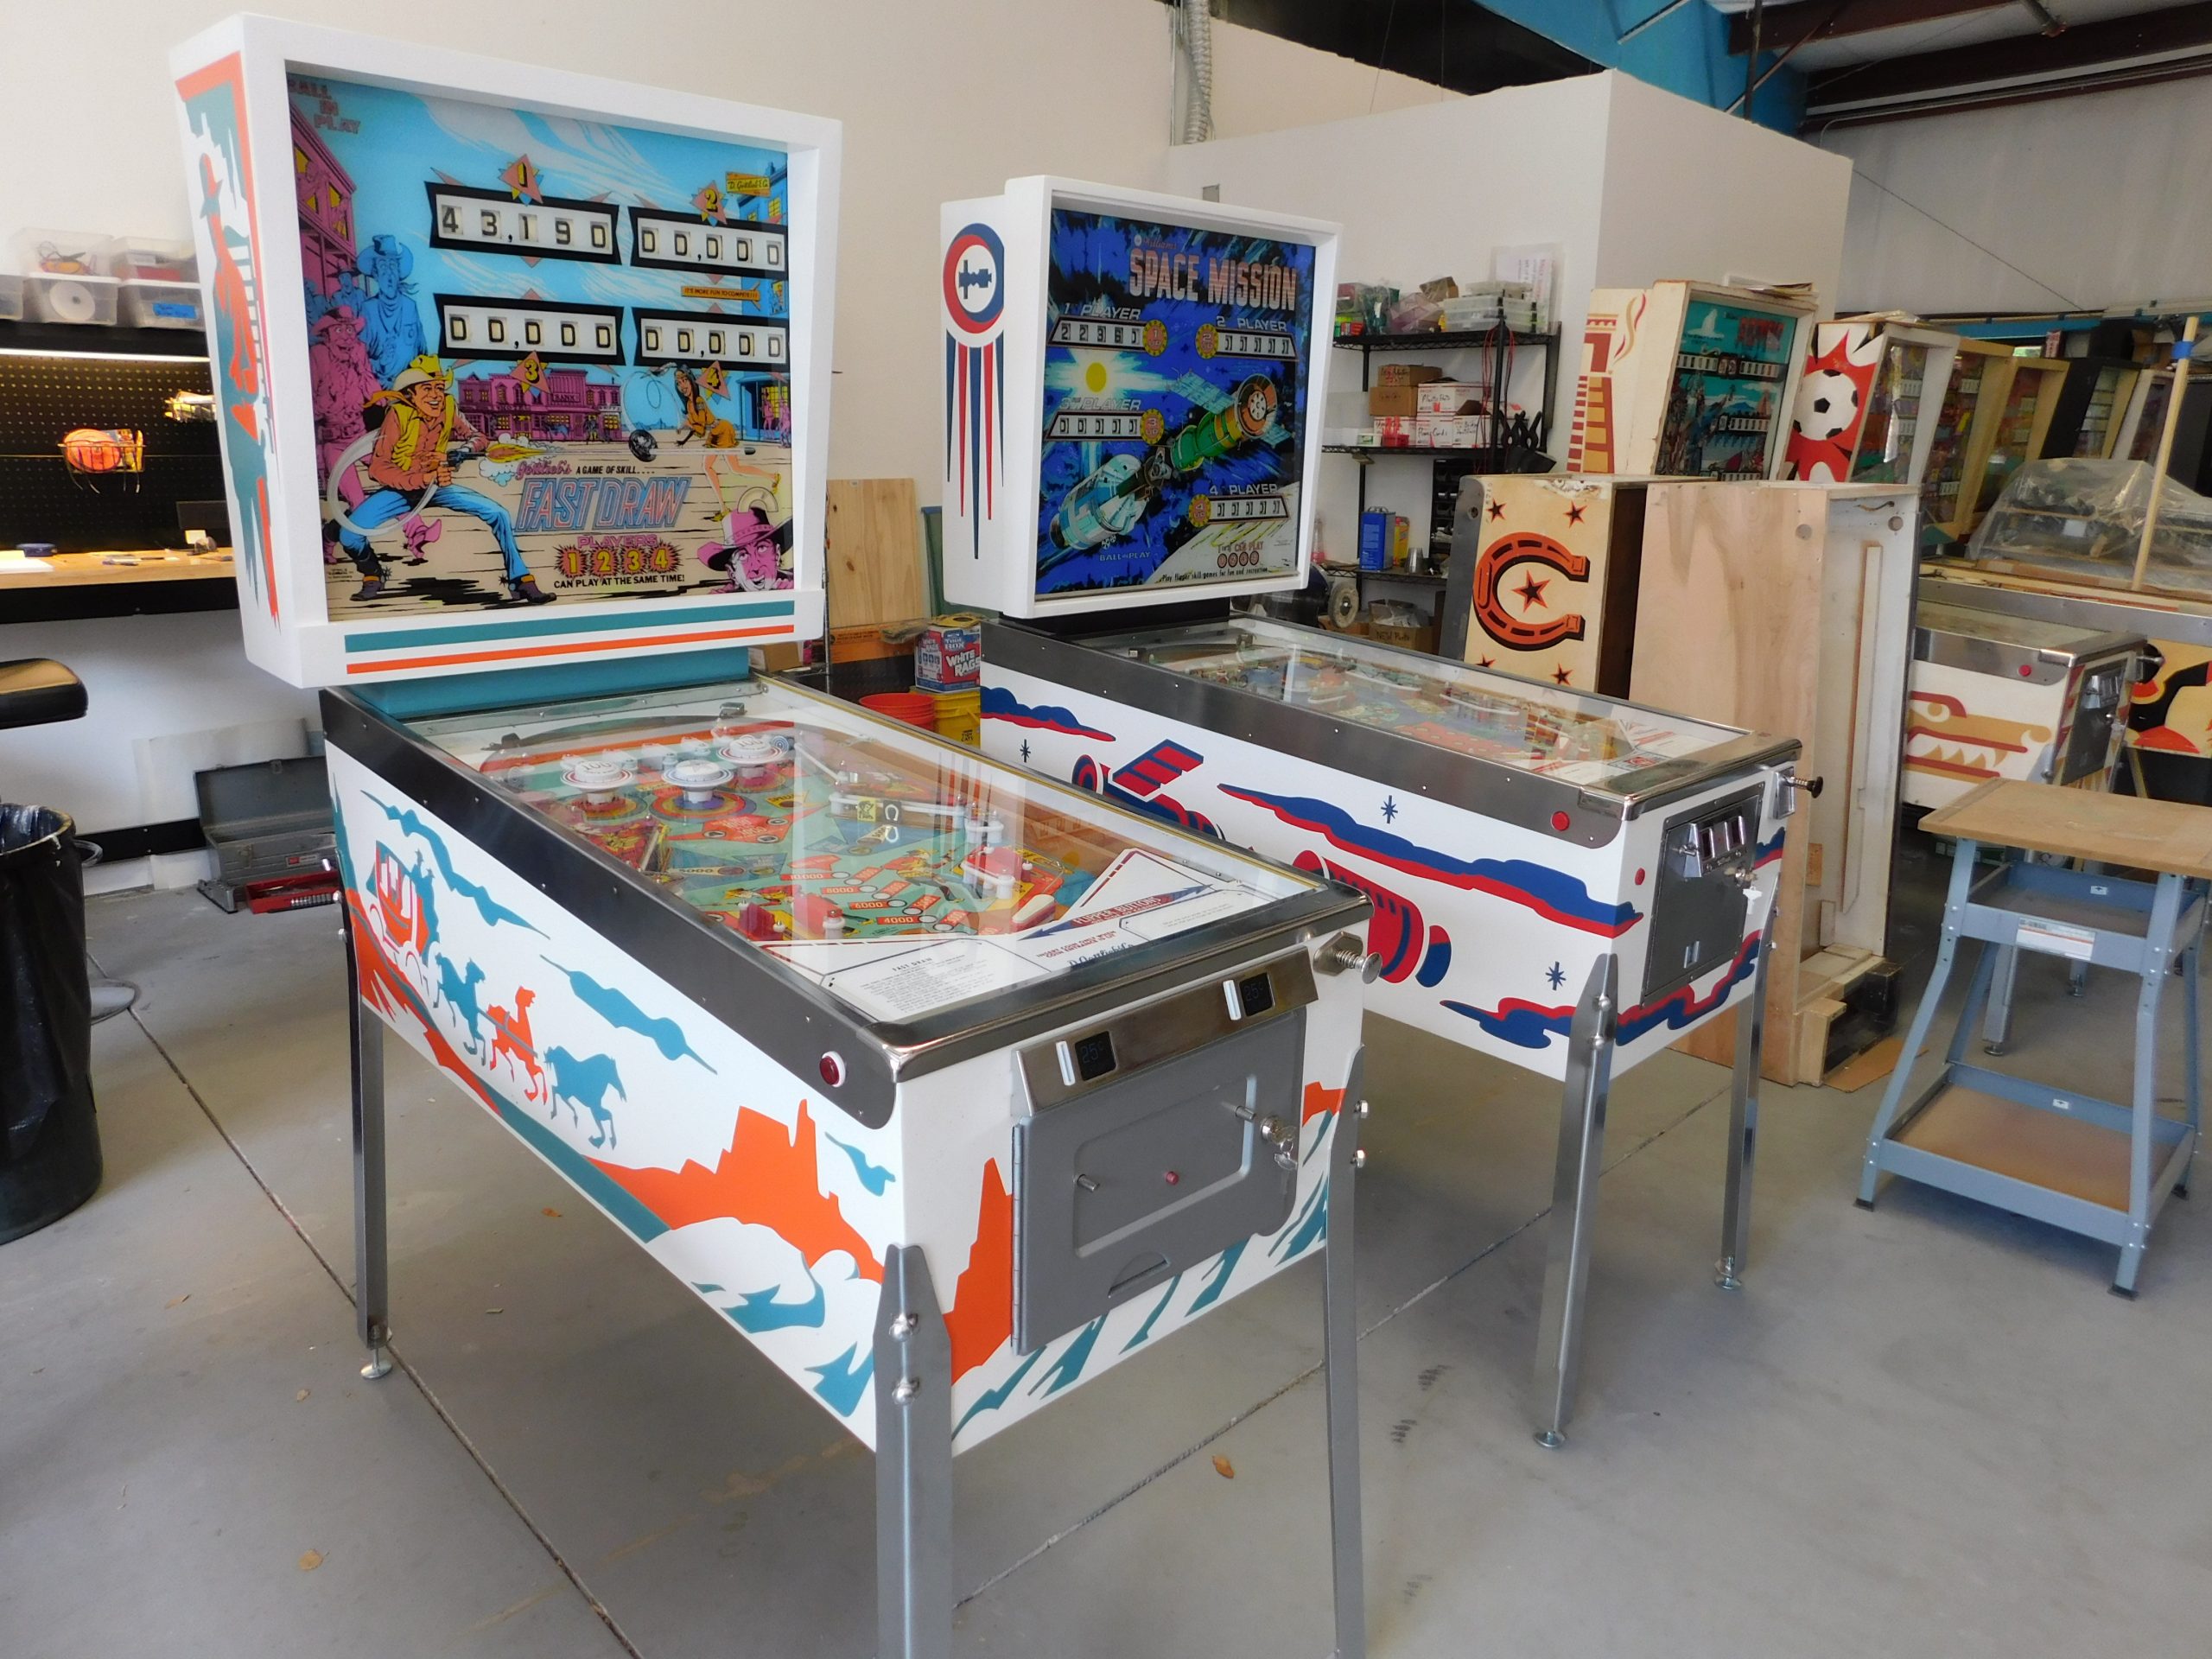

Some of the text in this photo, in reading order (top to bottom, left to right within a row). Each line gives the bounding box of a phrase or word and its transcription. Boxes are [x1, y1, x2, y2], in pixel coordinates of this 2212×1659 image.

[704, 188, 718, 213] 2
[1129, 247, 1297, 311] SPACE MISSION
[1080, 304, 1141, 321] PLAYER
[1216, 315, 1287, 332] 2 PLAYER
[524, 359, 541, 384] 3
[1080, 397, 1141, 411] PLAYER
[575, 466, 582, 474] A
[582, 465, 604, 474] GAME
[606, 465, 615, 474] OF
[1209, 483, 1278, 495] 4 PLAYER
[513, 476, 692, 532] FAST DRAW
[577, 534, 658, 550] PLAYERS
[567, 548, 669, 575] 1 2 3 4
[1099, 553, 1122, 562] BALL
[1128, 551, 1151, 560] PLAY
[554, 580, 574, 589] CAN
[575, 579, 599, 588] PLAY
[613, 576, 632, 585] THE
[633, 575, 658, 584] SAME
[661, 574, 685, 582] TIME!
[945, 650, 975, 667] WHITE
[955, 657, 981, 677] RAGS
[1115, 896, 1162, 912] BUTTONS
